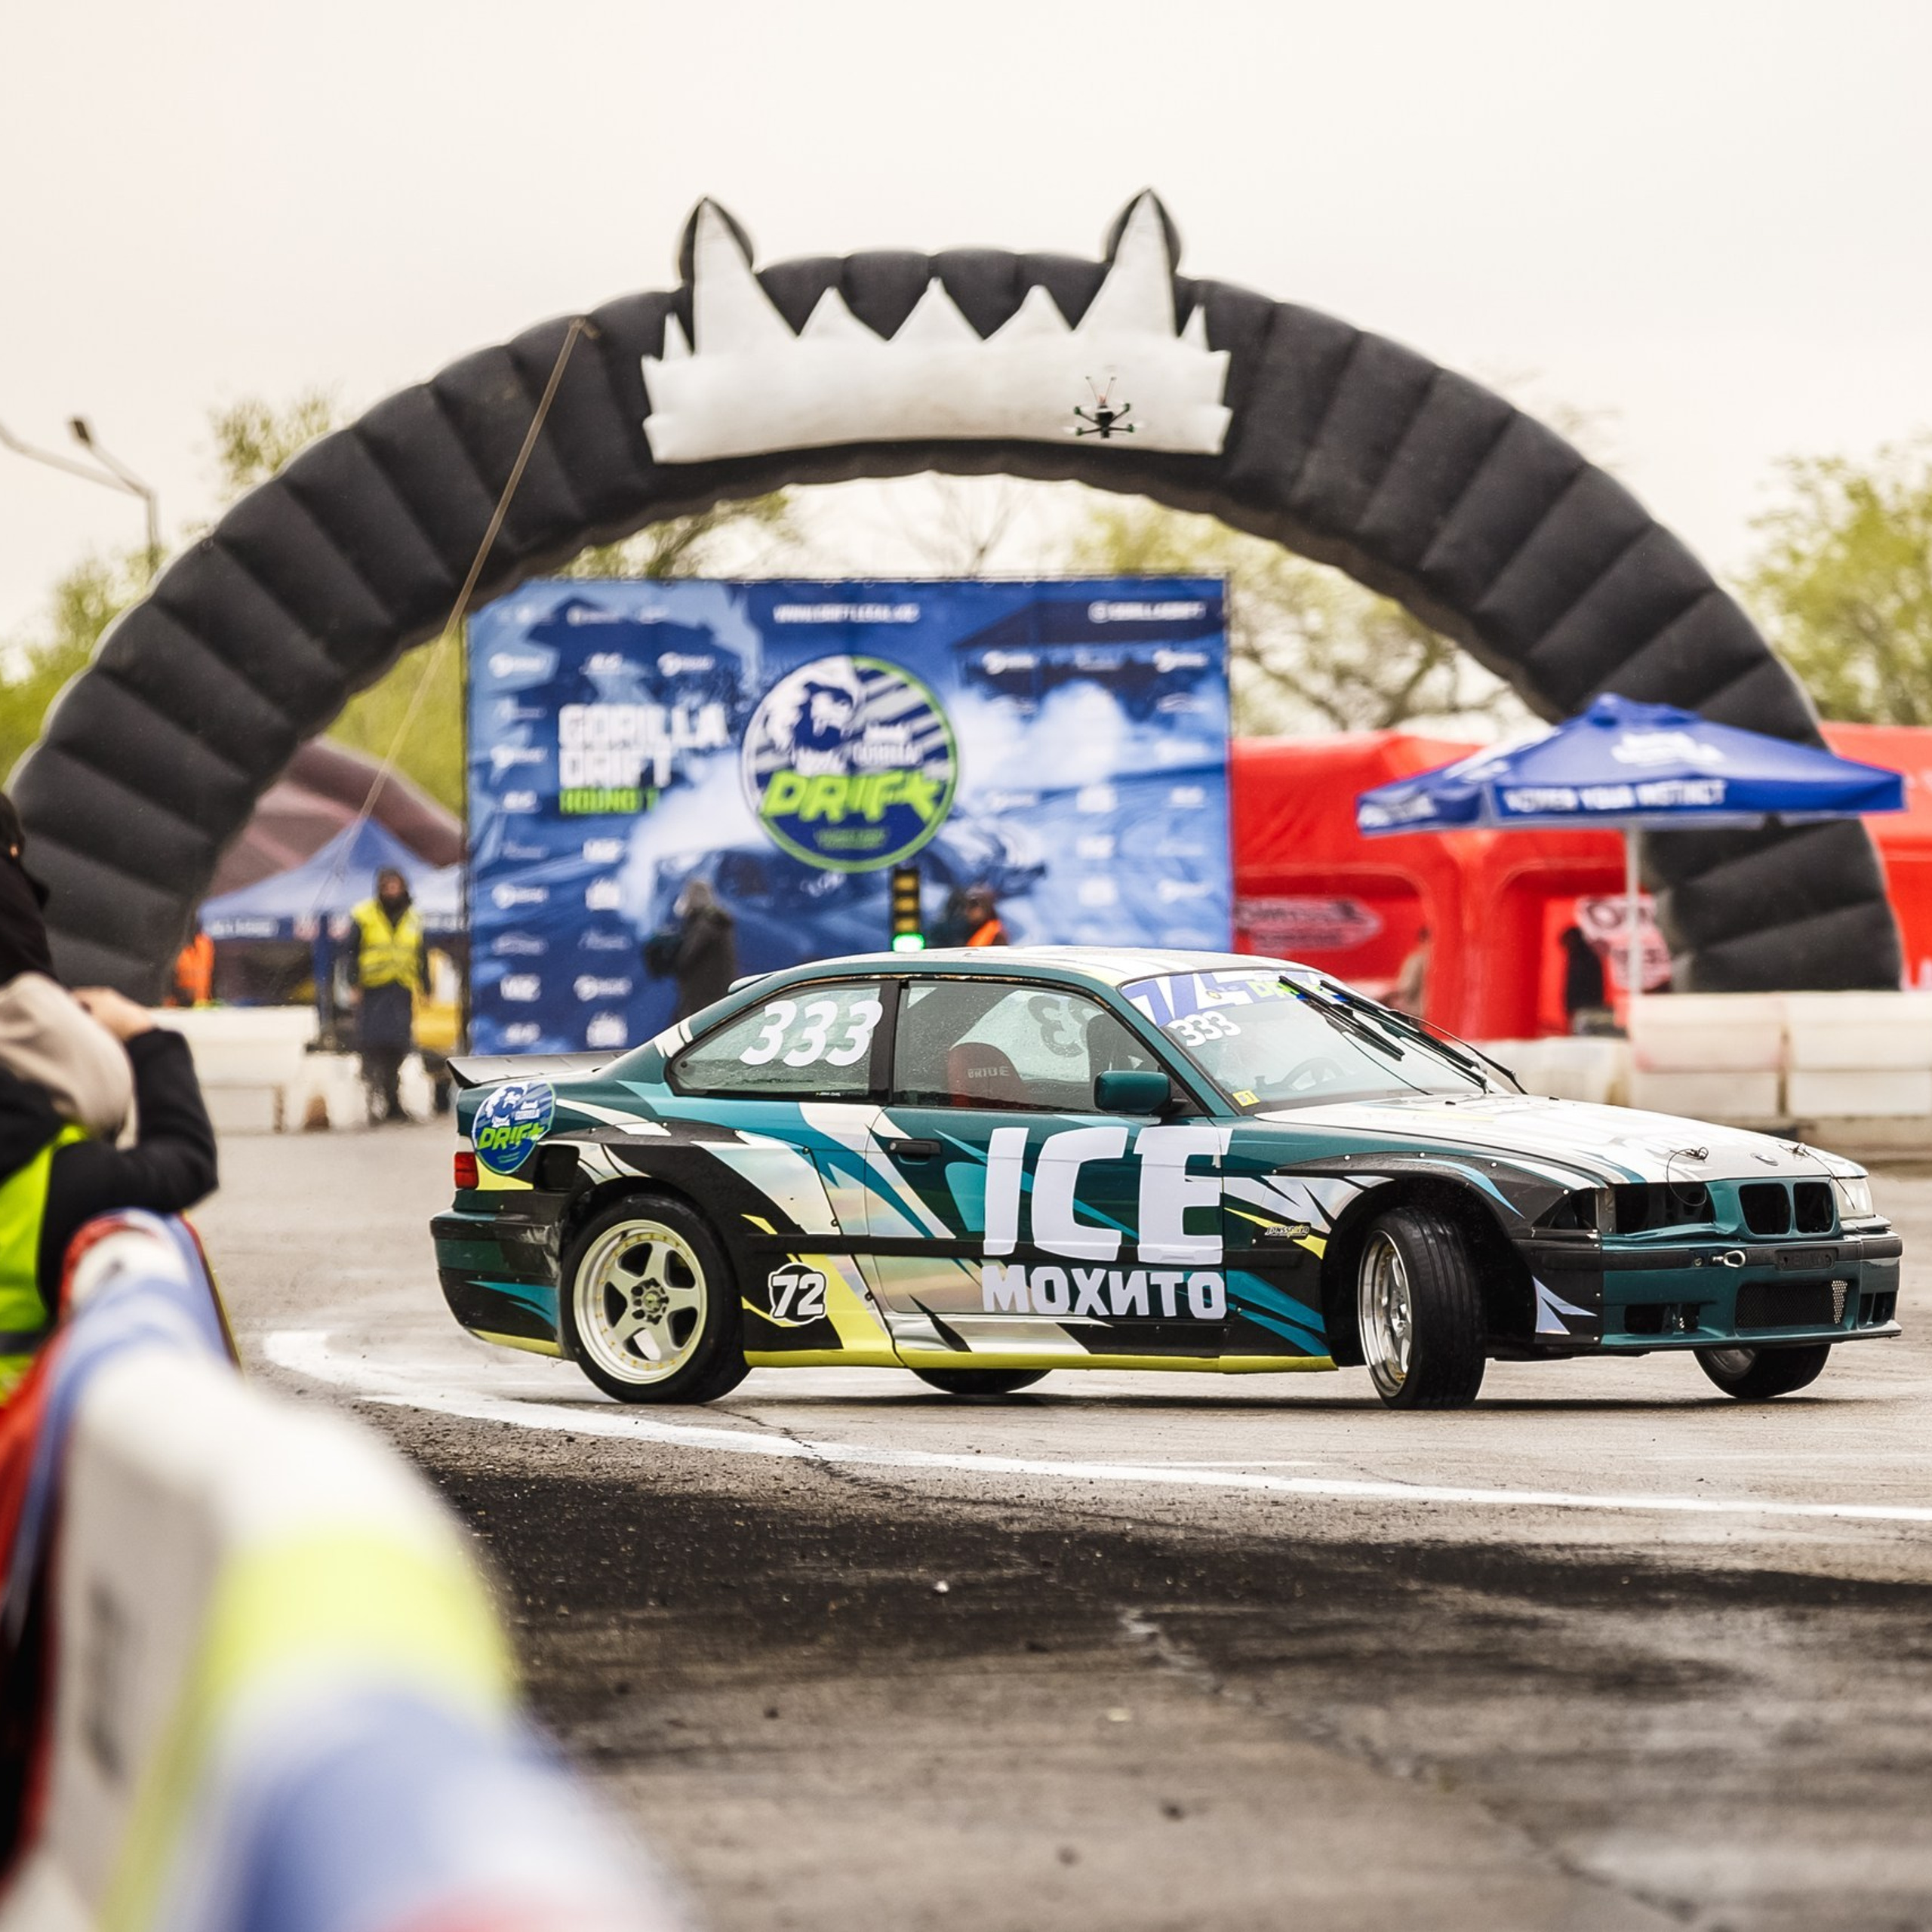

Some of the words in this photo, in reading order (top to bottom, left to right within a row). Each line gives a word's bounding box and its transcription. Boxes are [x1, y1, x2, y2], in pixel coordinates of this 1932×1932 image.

[558, 703, 730, 748] GORILLA
[739, 1000, 883, 1067] 333
[1167, 1011, 1241, 1048] 333
[983, 1125, 1234, 1265] ICE
[771, 1273, 825, 1318] 72
[982, 1264, 1227, 1319] МОХИТО
